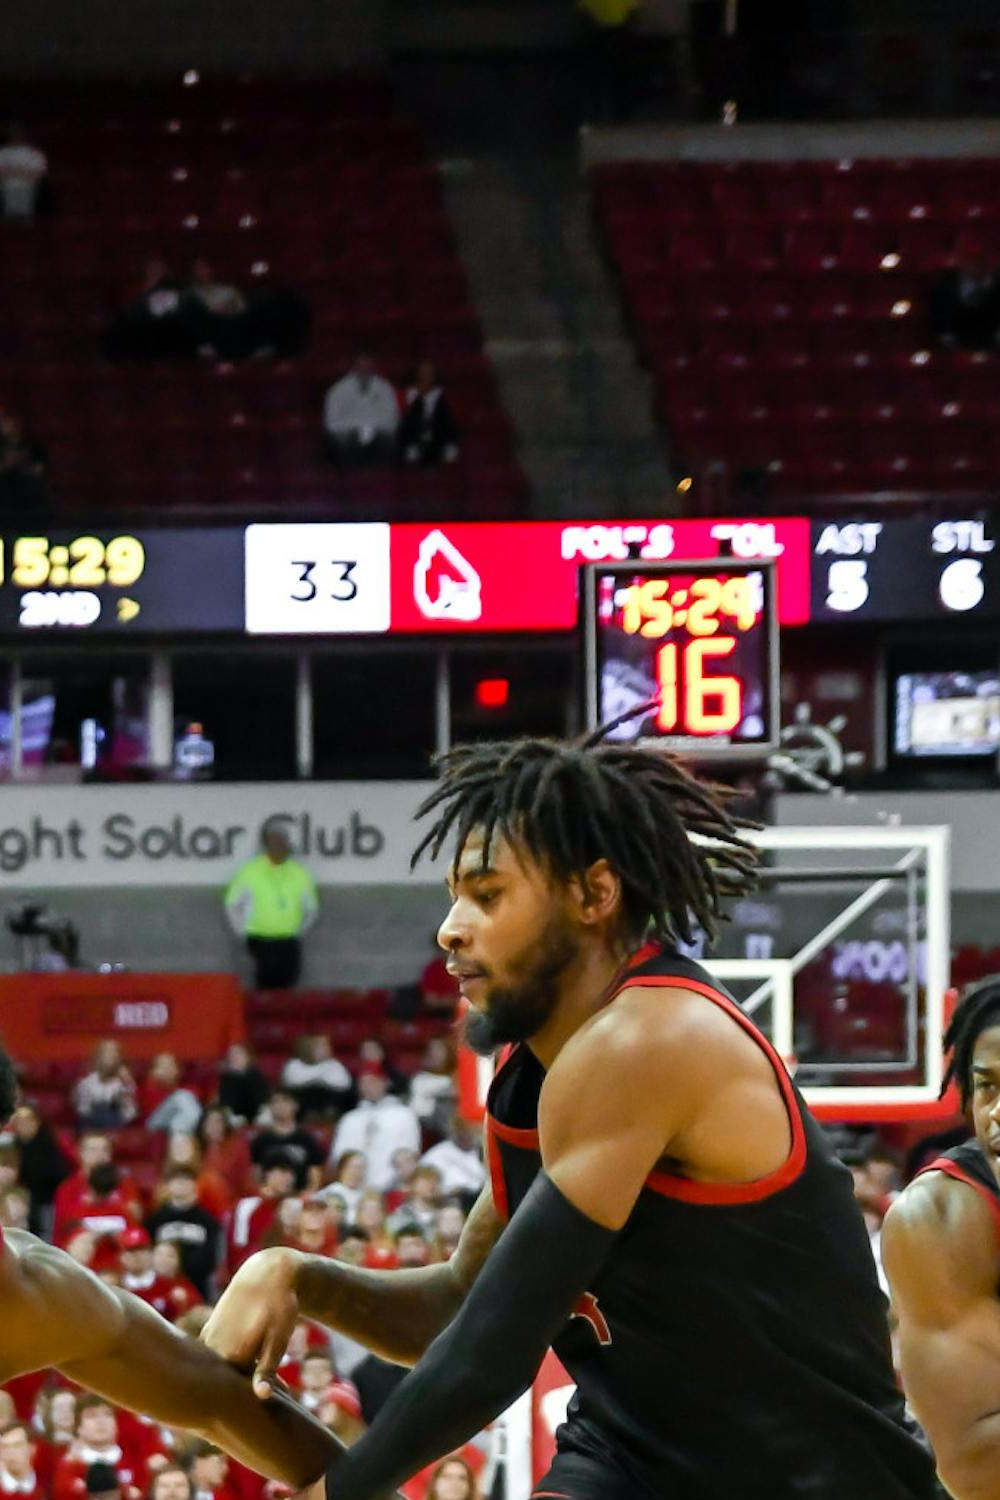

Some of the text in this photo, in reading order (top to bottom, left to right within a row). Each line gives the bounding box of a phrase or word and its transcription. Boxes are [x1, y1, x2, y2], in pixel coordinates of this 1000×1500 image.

[815, 522, 883, 555] AST
[931, 521, 996, 553] STL
[290, 560, 360, 602] 33
[825, 560, 869, 612] 5
[939, 558, 985, 612] 6
[657, 633, 744, 737] 16
[102, 812, 247, 860] Solar
